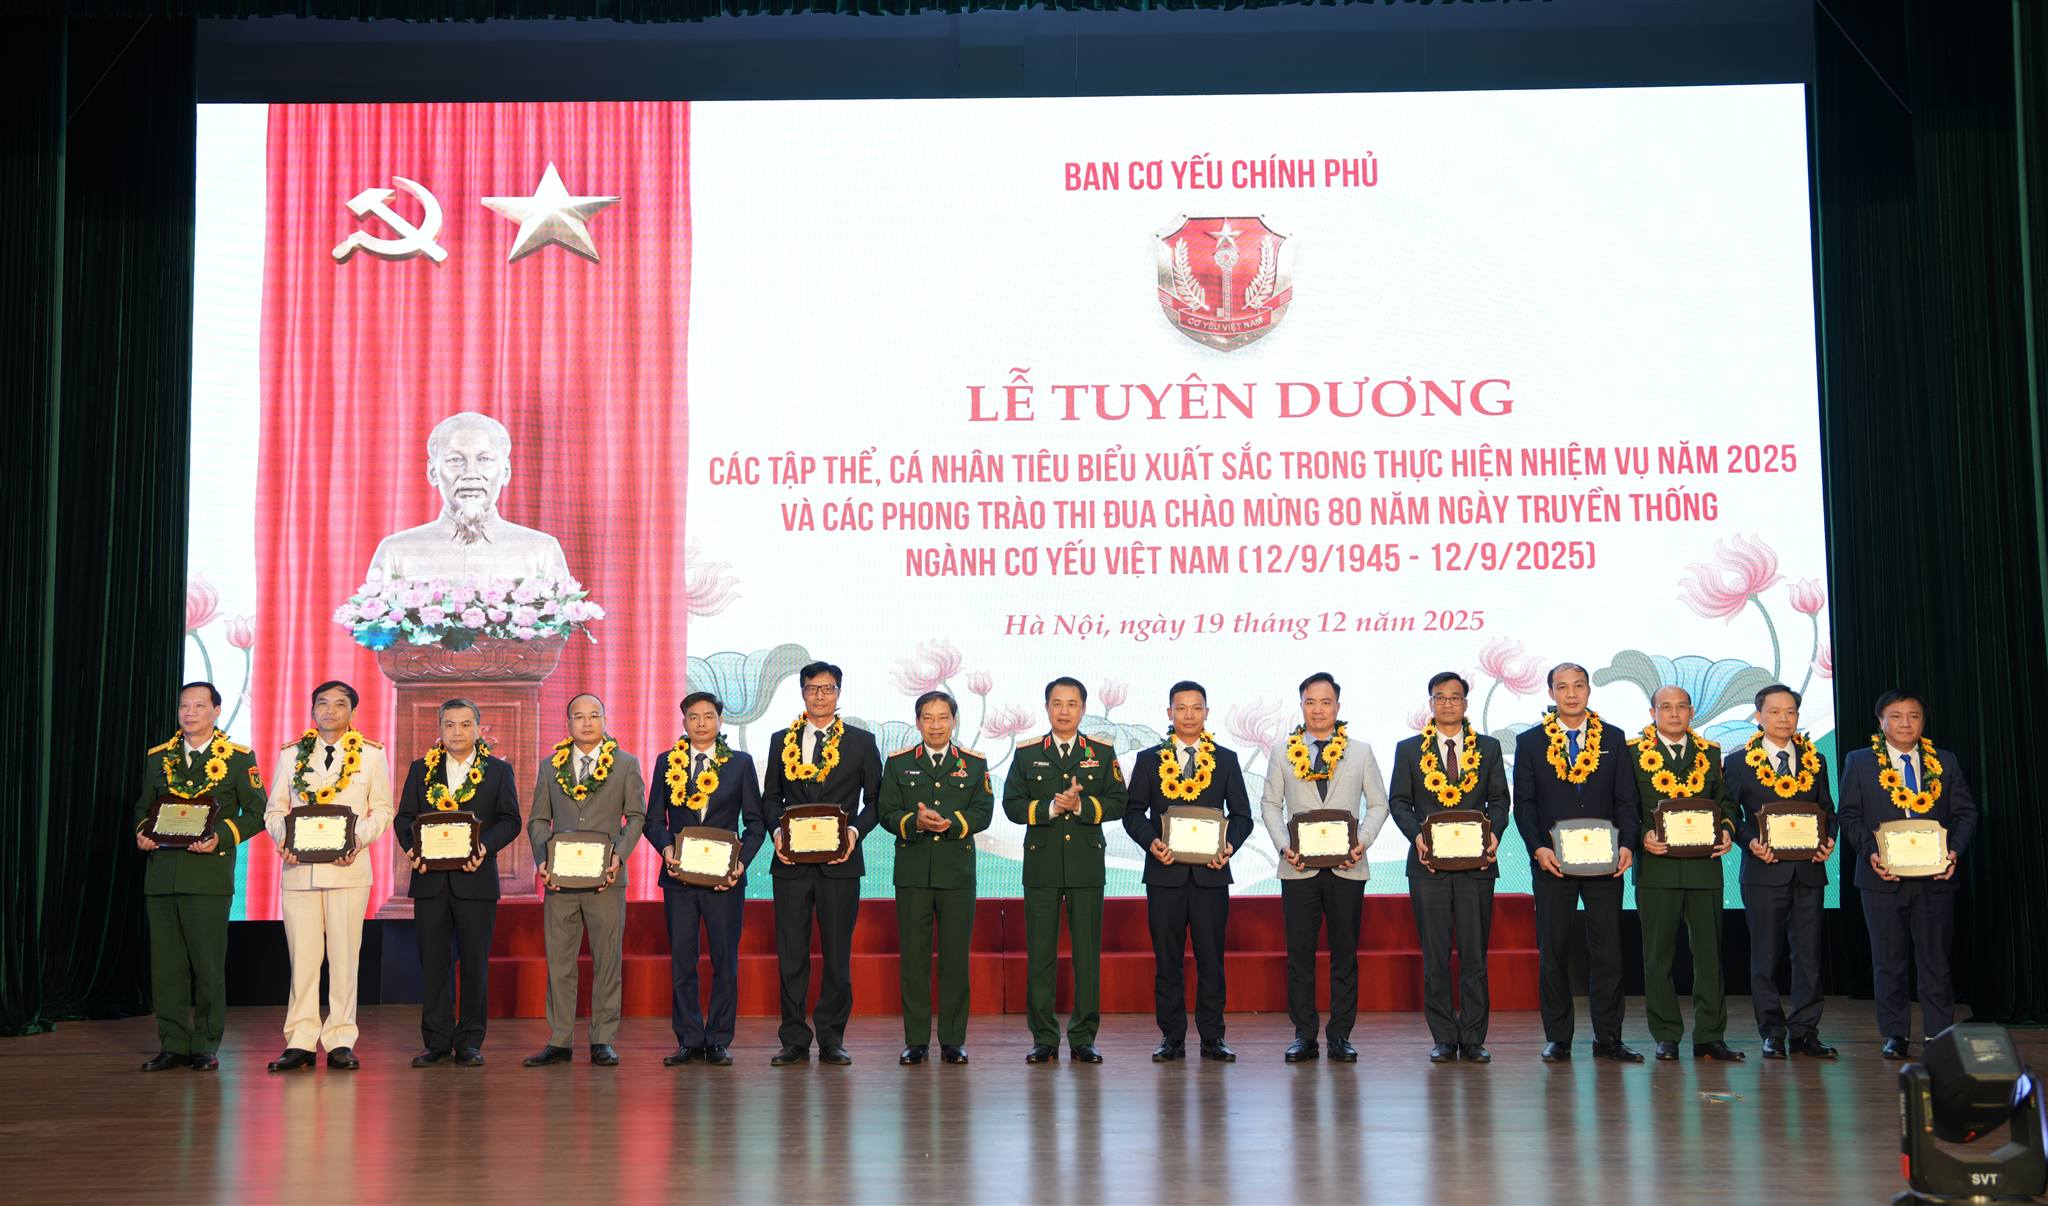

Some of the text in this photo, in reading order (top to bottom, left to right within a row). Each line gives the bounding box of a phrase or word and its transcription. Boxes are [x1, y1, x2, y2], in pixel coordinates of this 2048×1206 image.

[1065, 150, 1378, 191] BAN CƠ YẾU CHÍNH PHỦ
[1243, 316, 1264, 329] NAM
[967, 368, 1514, 422] LỄ TUYÊN DƯƠNG
[709, 441, 1797, 489] CÁC TẬP THỂ, CÁ NHÂN TIÊU BIỂU XUẤT SẮC TRONG THỰC HIỆN NHIỆM VỤ NĂM 2025
[781, 485, 1718, 531] VÀ CÁC PHONG TRÀO THI ĐUA CHÀO MỪNG 80 NĂM NGÀY TRUYỀN THỐNG
[906, 543, 995, 576] NGÀNH
[1005, 547, 1037, 576] CƠ
[1047, 541, 1096, 576] YẾU
[1105, 540, 1162, 579] VIỆT
[1170, 545, 1229, 574] NAM
[1239, 544, 1400, 573] (12/9/1945
[1433, 541, 1596, 571] 12/9/2025)
[1005, 610, 1484, 640] Hà Nội, ngày 19 tháng 12 năm 2025
[1971, 1173, 1997, 1185] SVT
